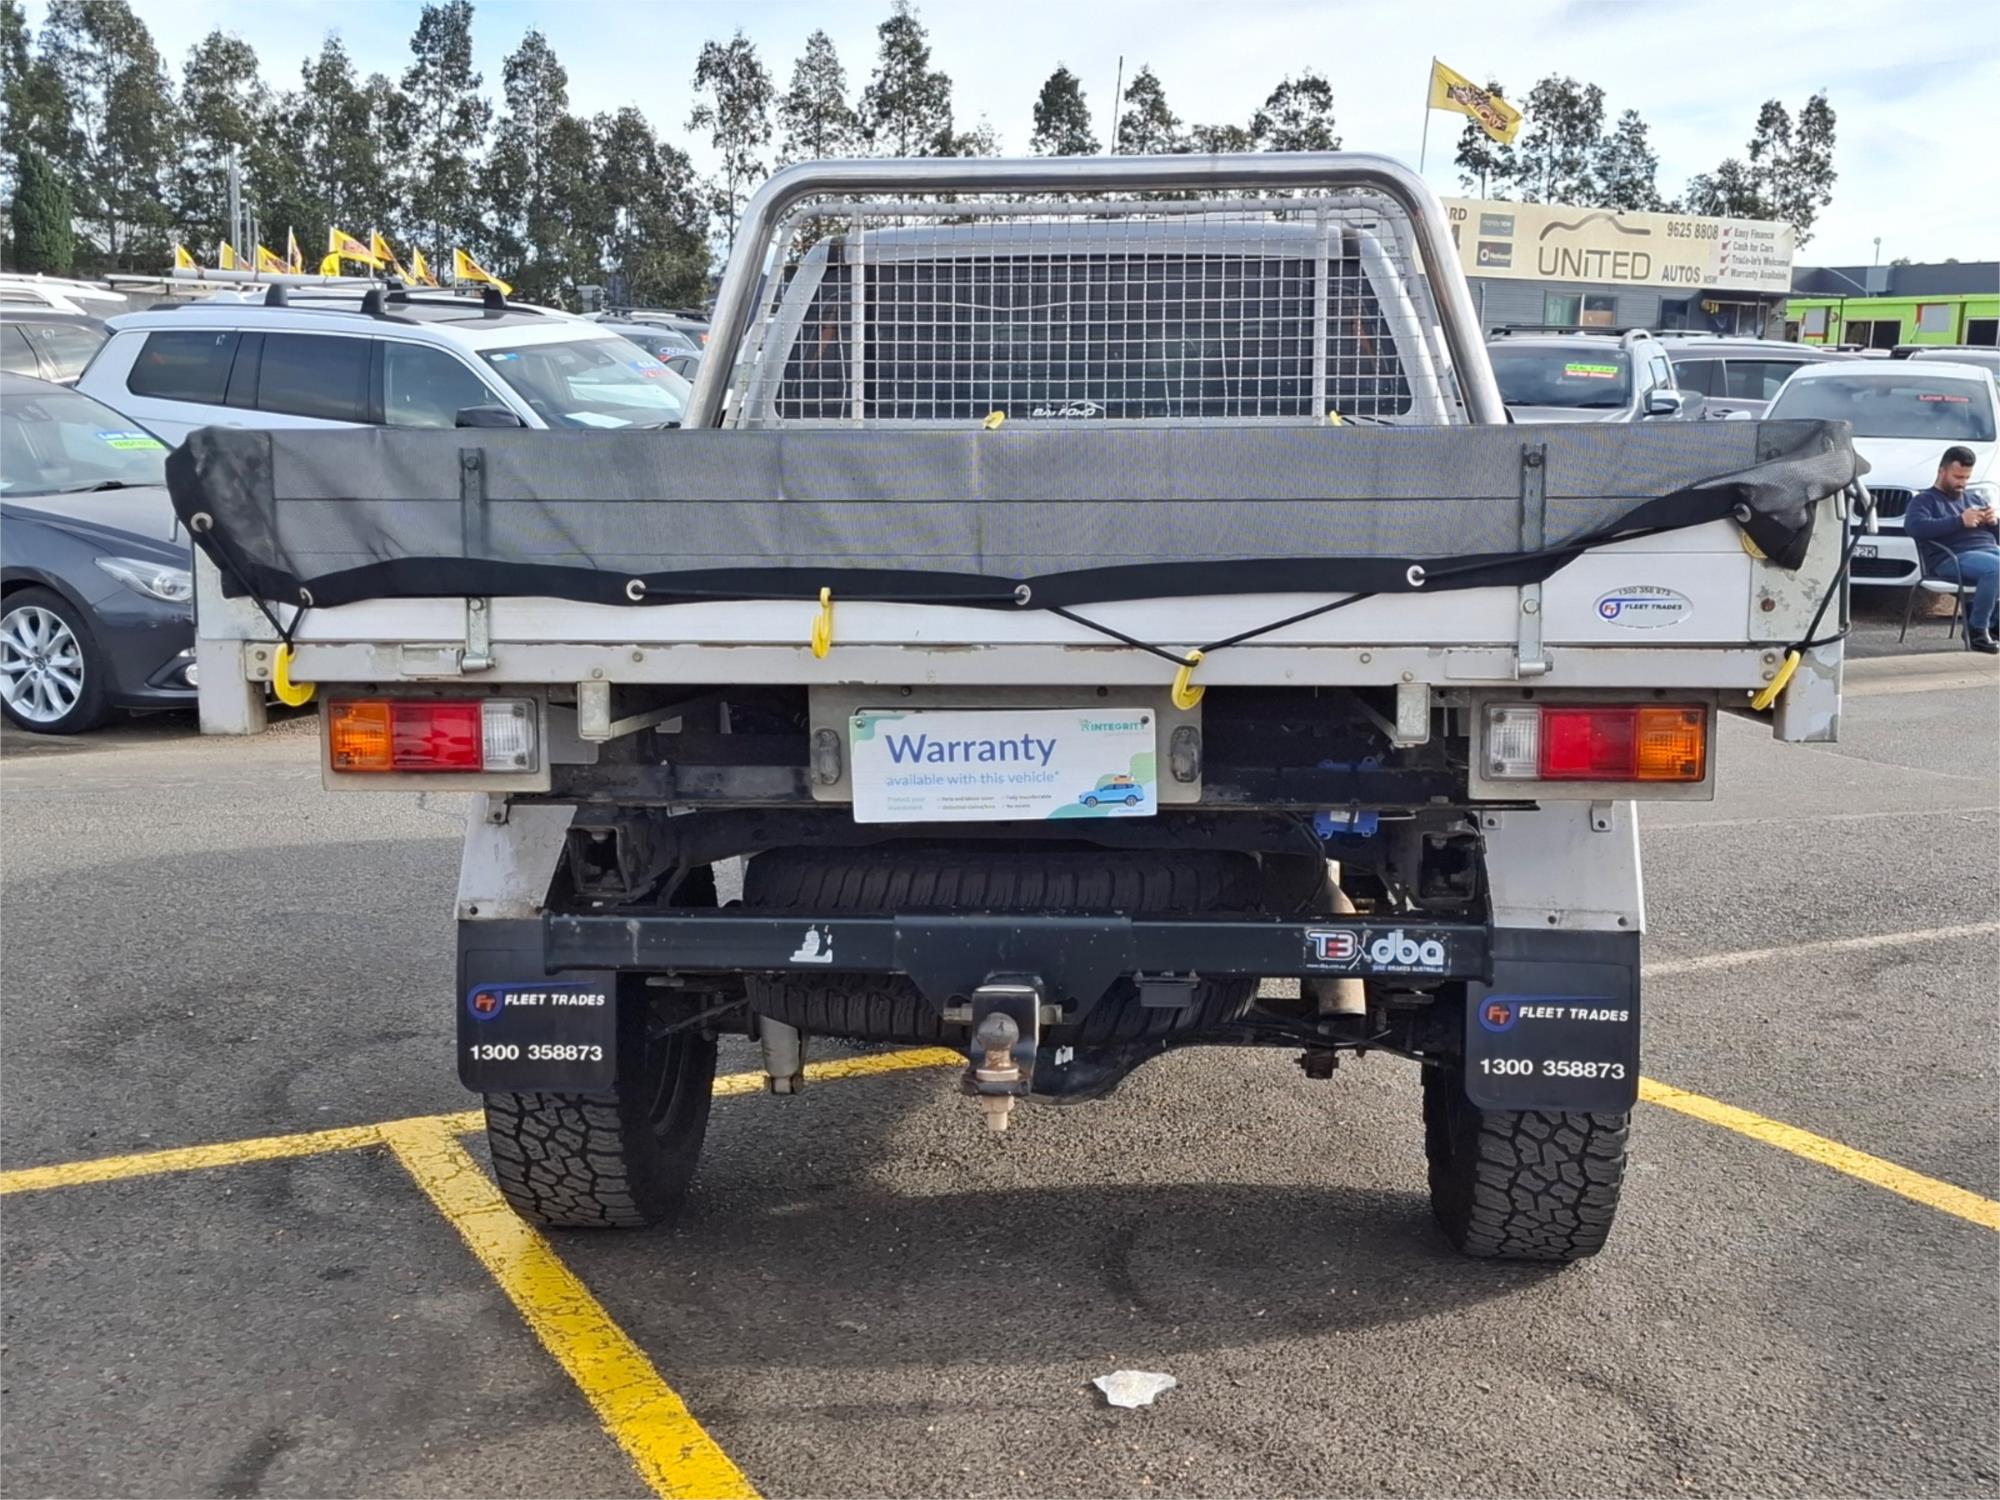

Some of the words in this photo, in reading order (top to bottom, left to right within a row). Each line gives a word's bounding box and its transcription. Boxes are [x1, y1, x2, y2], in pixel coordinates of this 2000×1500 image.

[1444, 206, 1467, 221] RD
[1667, 221, 1692, 238] 9625
[1694, 224, 1719, 241] 8808
[1751, 229, 1774, 240] Finance
[1733, 241, 1748, 252] Cash
[1760, 244, 1774, 253] Cars
[1763, 258, 1791, 267] Welcome
[1662, 264, 1701, 284] AUTOS
[1730, 268, 1759, 281] Warranty
[1760, 271, 1788, 281] Available
[1651, 603, 1682, 611] TRADES
[884, 733, 1057, 768] Warranty
[886, 774, 945, 787] available
[947, 772, 978, 786] with
[980, 771, 1005, 786] this
[1371, 929, 1445, 966] dba
[504, 994, 546, 1006] FLEET
[551, 994, 606, 1006] TRADES
[1519, 1006, 1565, 1019] FLEET
[1570, 1008, 1629, 1022] TRADES
[470, 1044, 520, 1060] 1300
[527, 1044, 603, 1061] 358873
[1480, 1058, 1534, 1075] 1300
[1541, 1060, 1625, 1080] 358873
